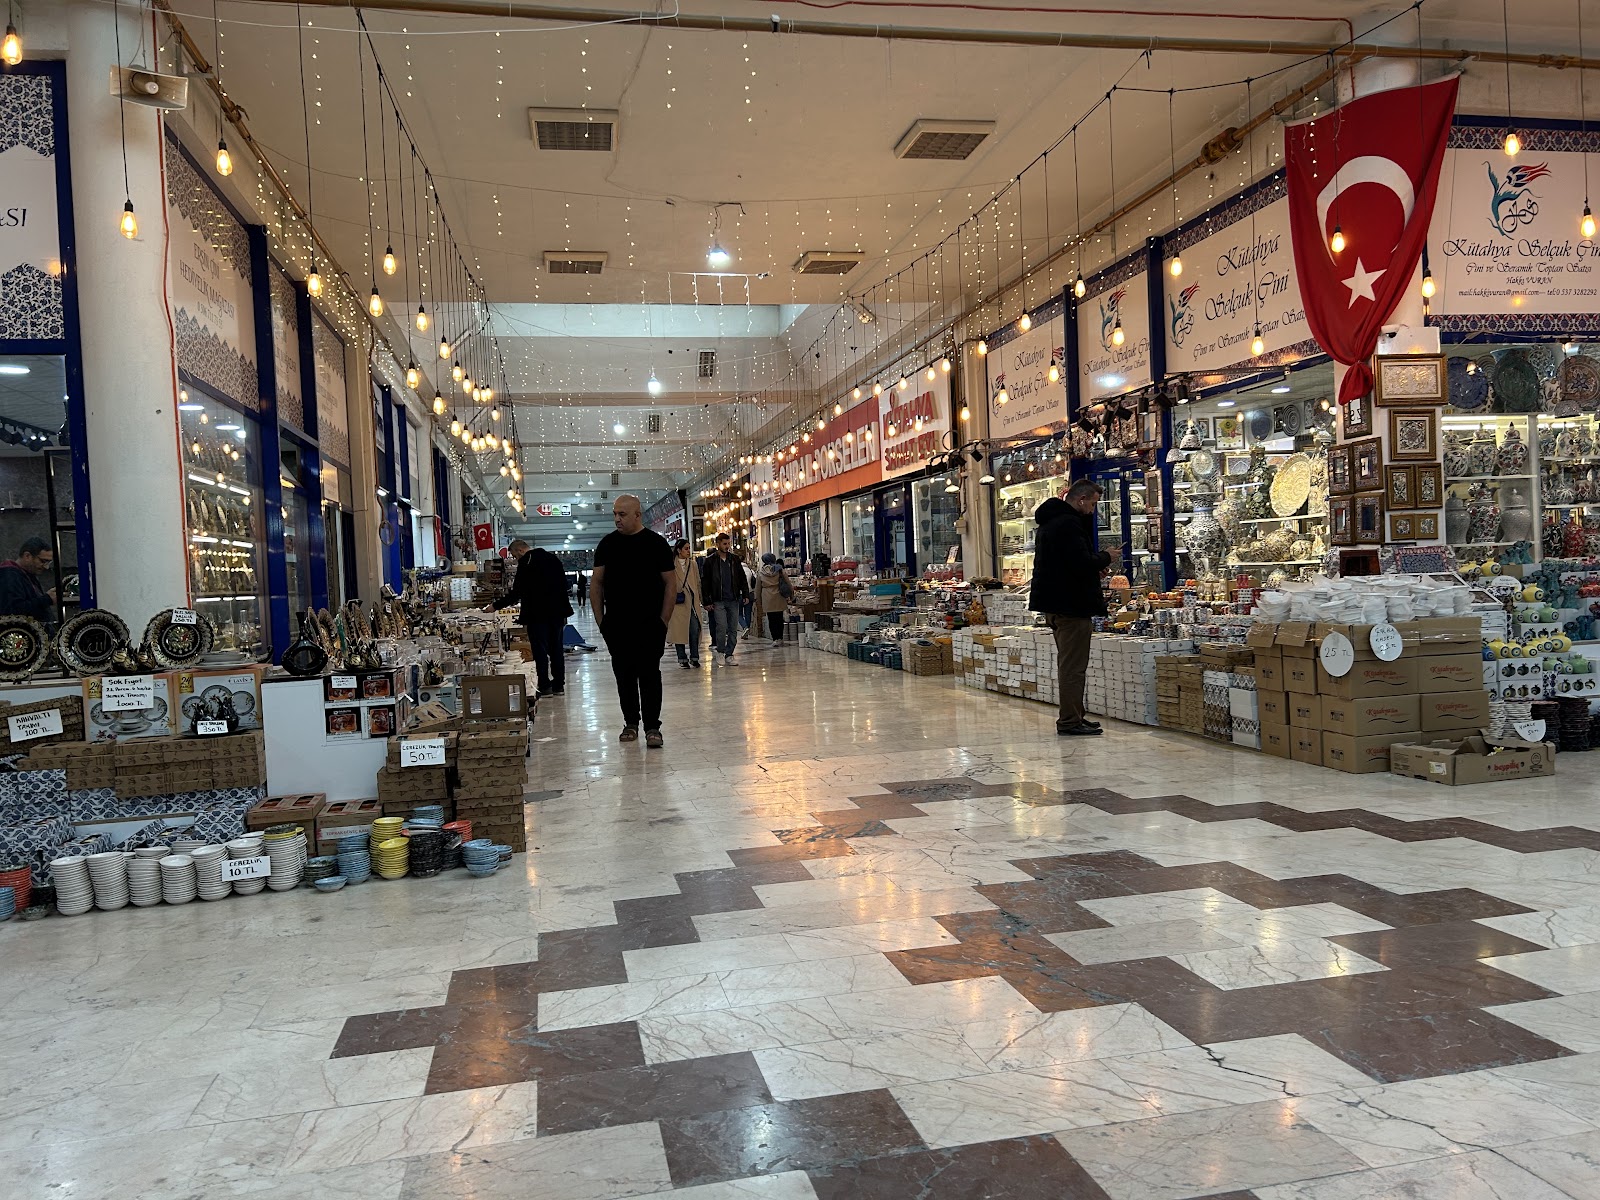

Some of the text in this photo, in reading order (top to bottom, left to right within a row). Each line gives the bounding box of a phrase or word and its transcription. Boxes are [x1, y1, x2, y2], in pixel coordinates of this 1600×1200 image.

[1216, 234, 1280, 276] Kütahya
[1443, 238, 1512, 262] Kütahya
[1518, 239, 1572, 261] Selçuk
[1465, 262, 1484, 275] Çini
[1496, 262, 1534, 273] Seramik
[1535, 262, 1564, 275] Toptan
[1204, 270, 1290, 320] Selçuk Çini
[814, 421, 880, 482] PORSELEN
[1324, 646, 1338, 658] 25
[16, 712, 50, 724] KAHVALTI
[25, 728, 38, 736] 100
[230, 866, 258, 877] 10 TL
